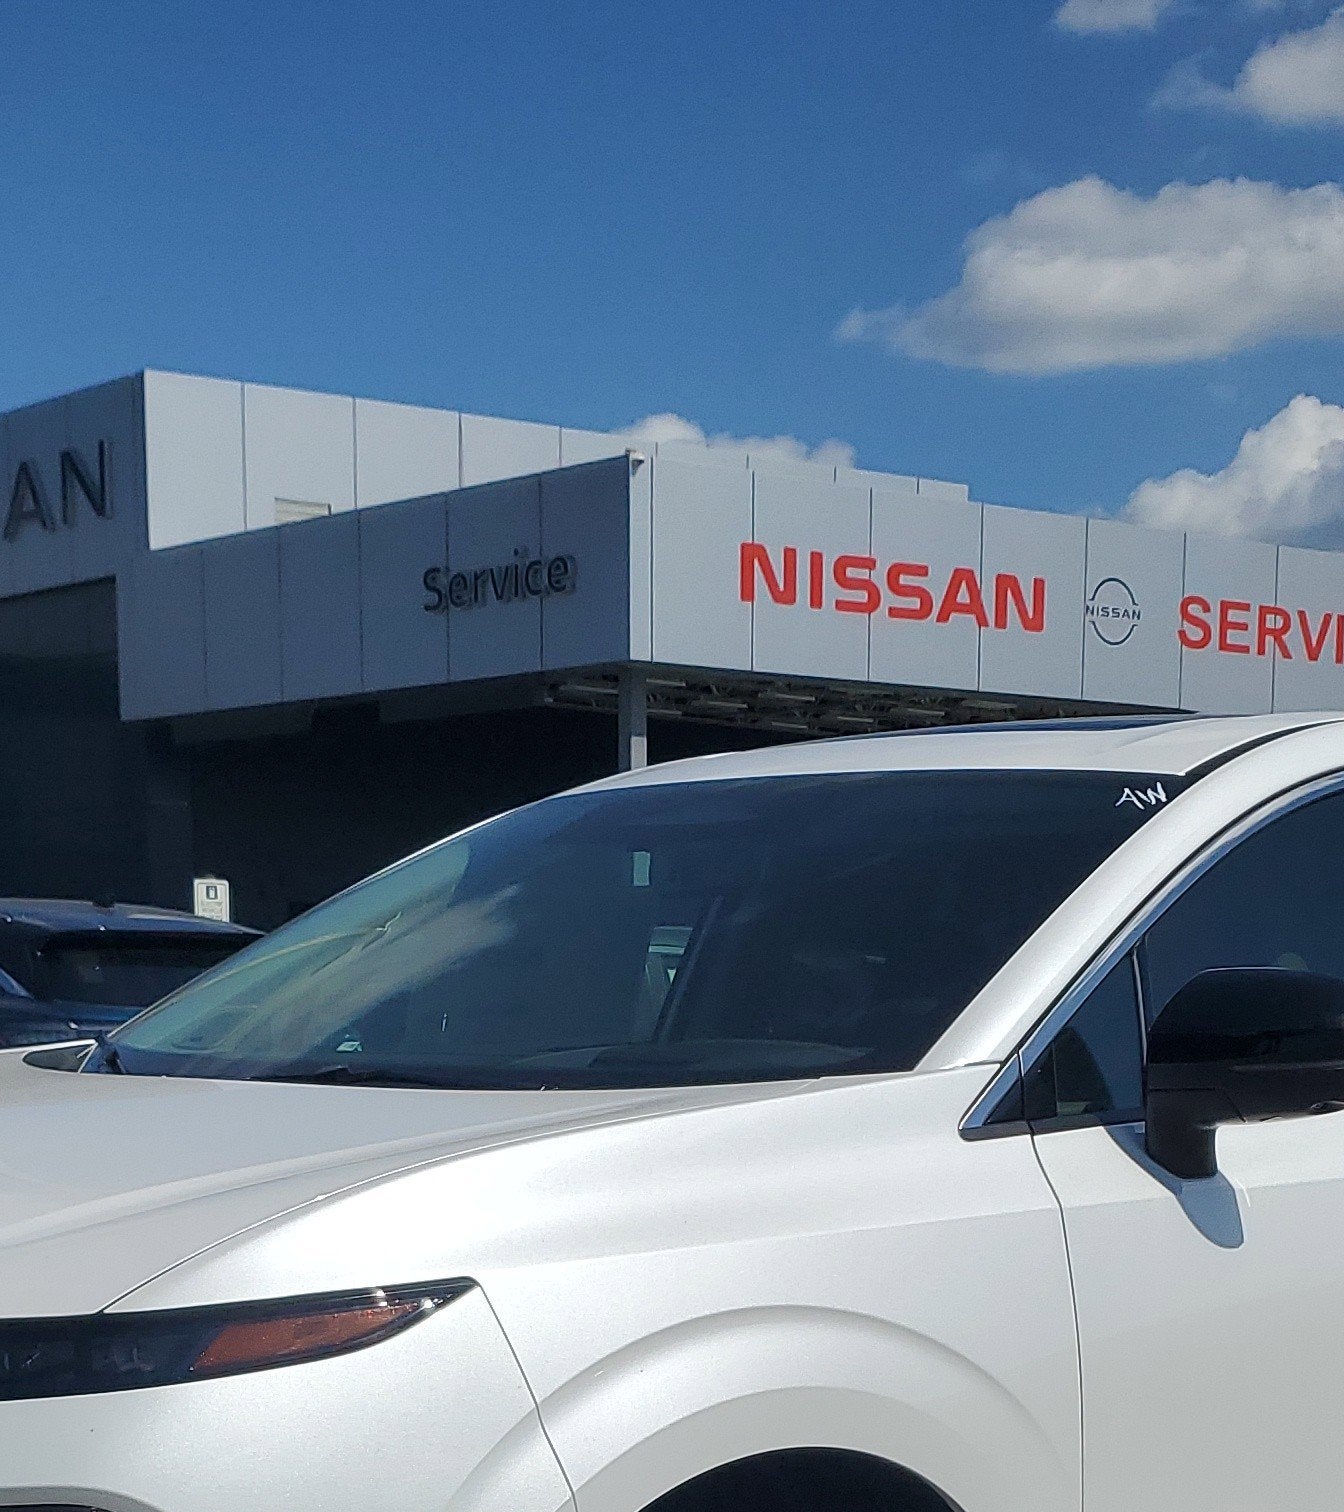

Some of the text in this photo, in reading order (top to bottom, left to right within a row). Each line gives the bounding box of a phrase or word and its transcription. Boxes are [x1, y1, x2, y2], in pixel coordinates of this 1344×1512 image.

[422, 547, 572, 612] Service
[739, 541, 1046, 633] NISSAN
[1085, 603, 1141, 621] NISSAN
